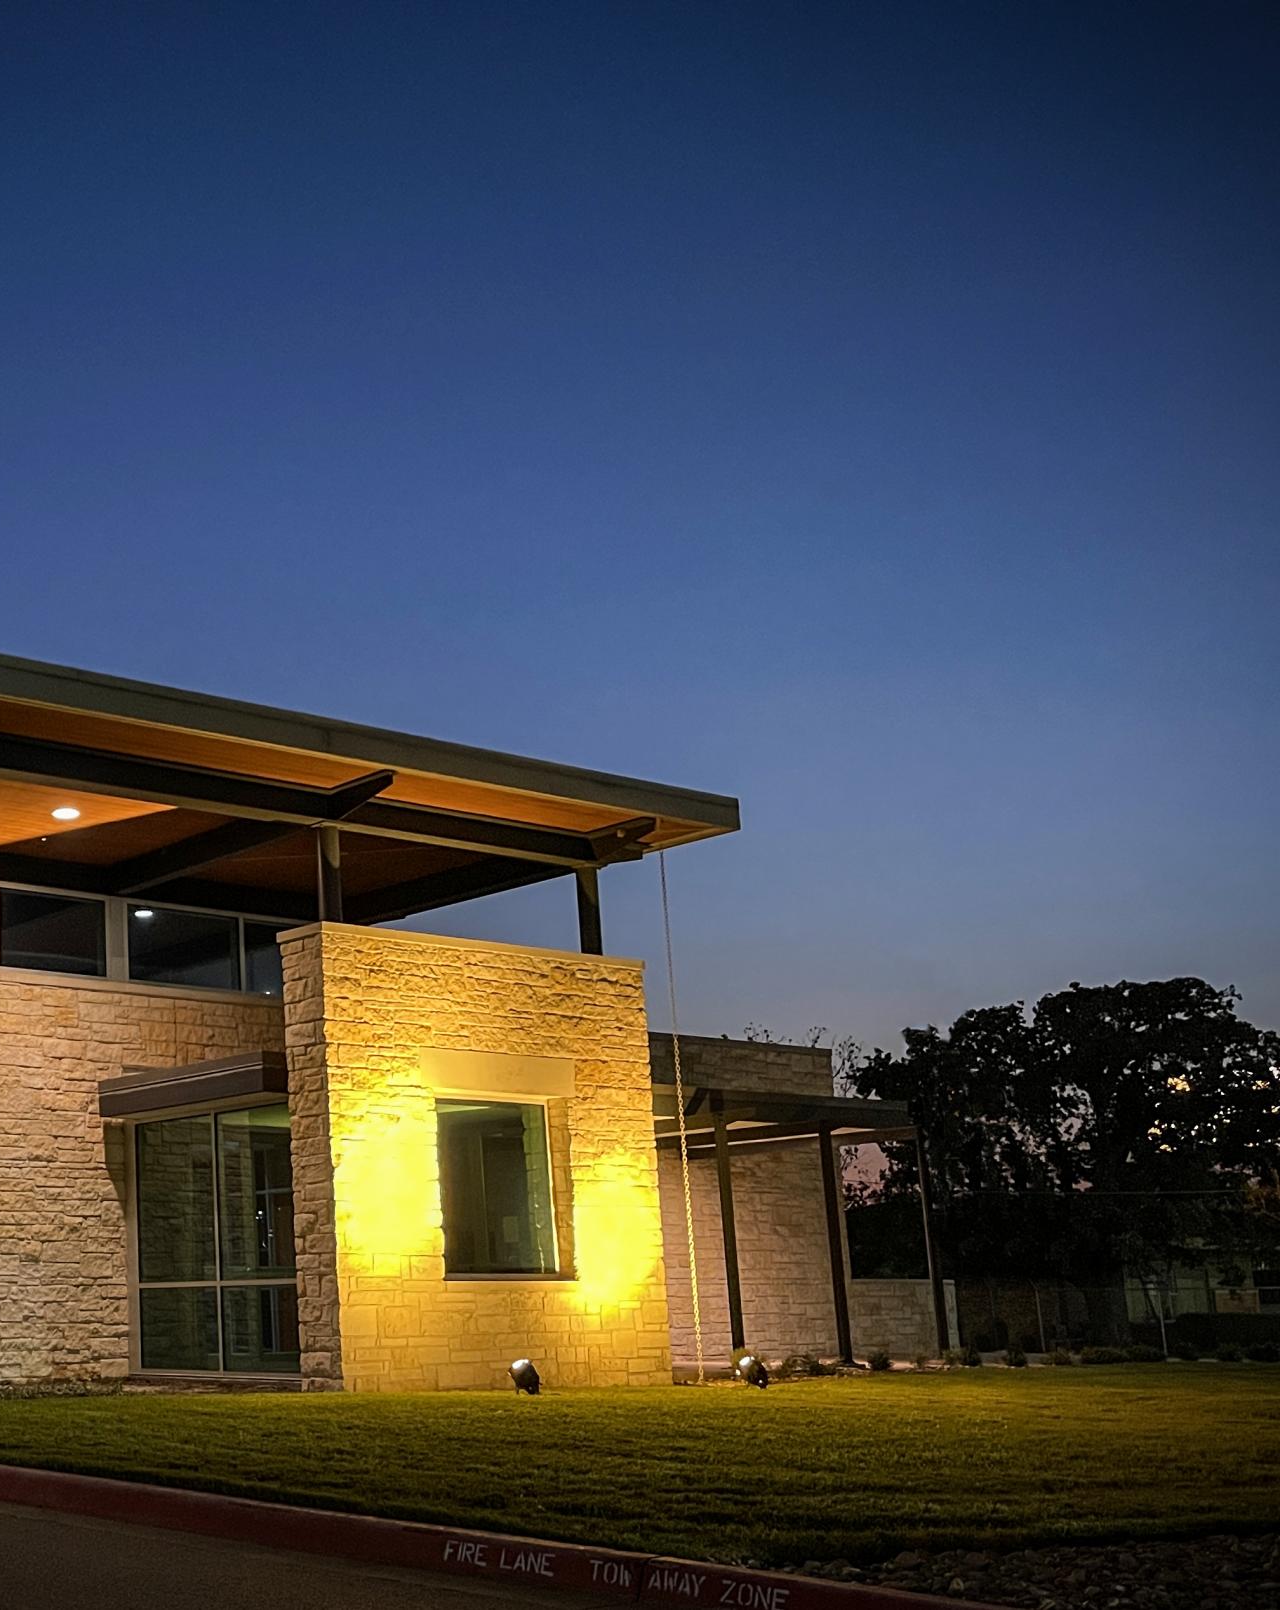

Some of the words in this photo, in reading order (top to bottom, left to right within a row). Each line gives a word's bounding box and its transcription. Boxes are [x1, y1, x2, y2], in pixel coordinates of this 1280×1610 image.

[443, 1540, 488, 1567] FIRE
[499, 1548, 556, 1577] LANE
[648, 1569, 706, 1598] AWAY
[720, 1580, 790, 1610] ZONE
